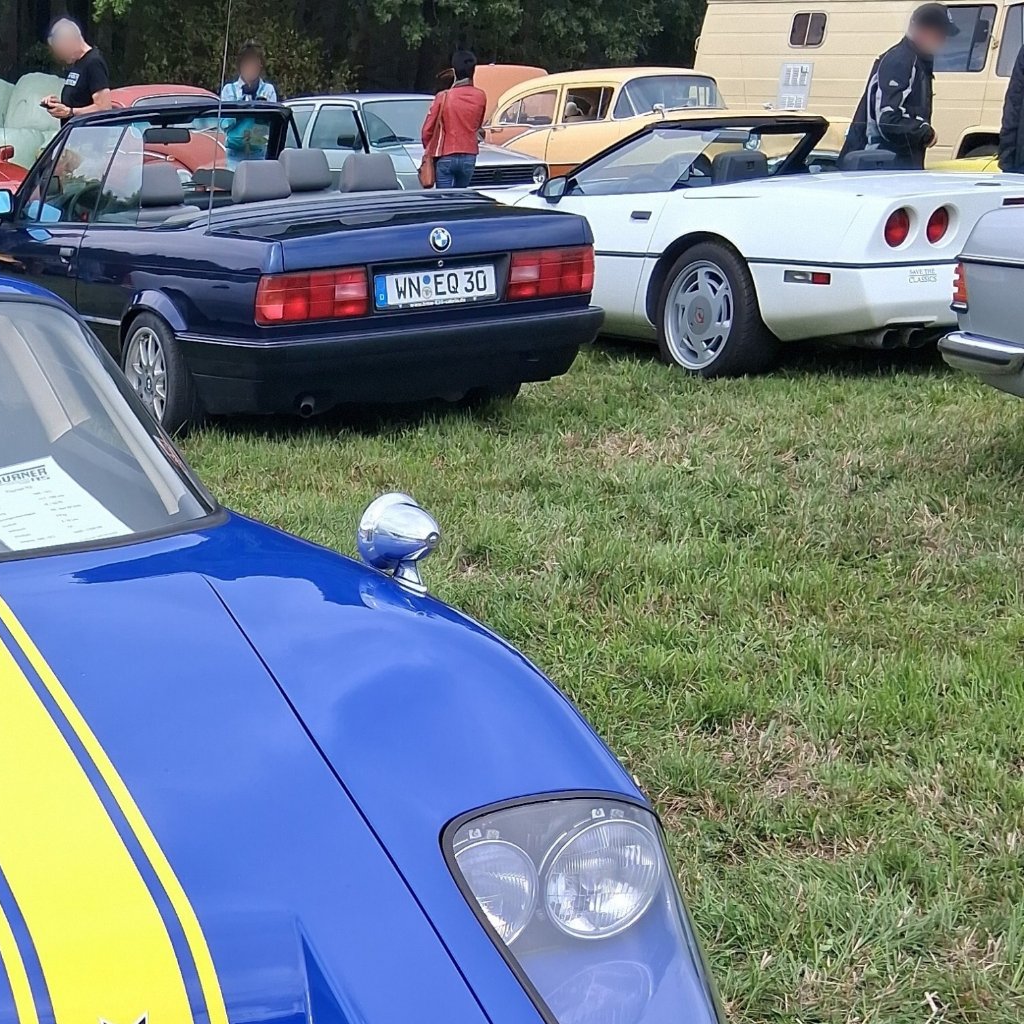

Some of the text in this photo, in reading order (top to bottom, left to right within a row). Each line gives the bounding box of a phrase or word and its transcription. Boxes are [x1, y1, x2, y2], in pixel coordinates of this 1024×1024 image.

[395, 270, 487, 300] WN EQ 30
